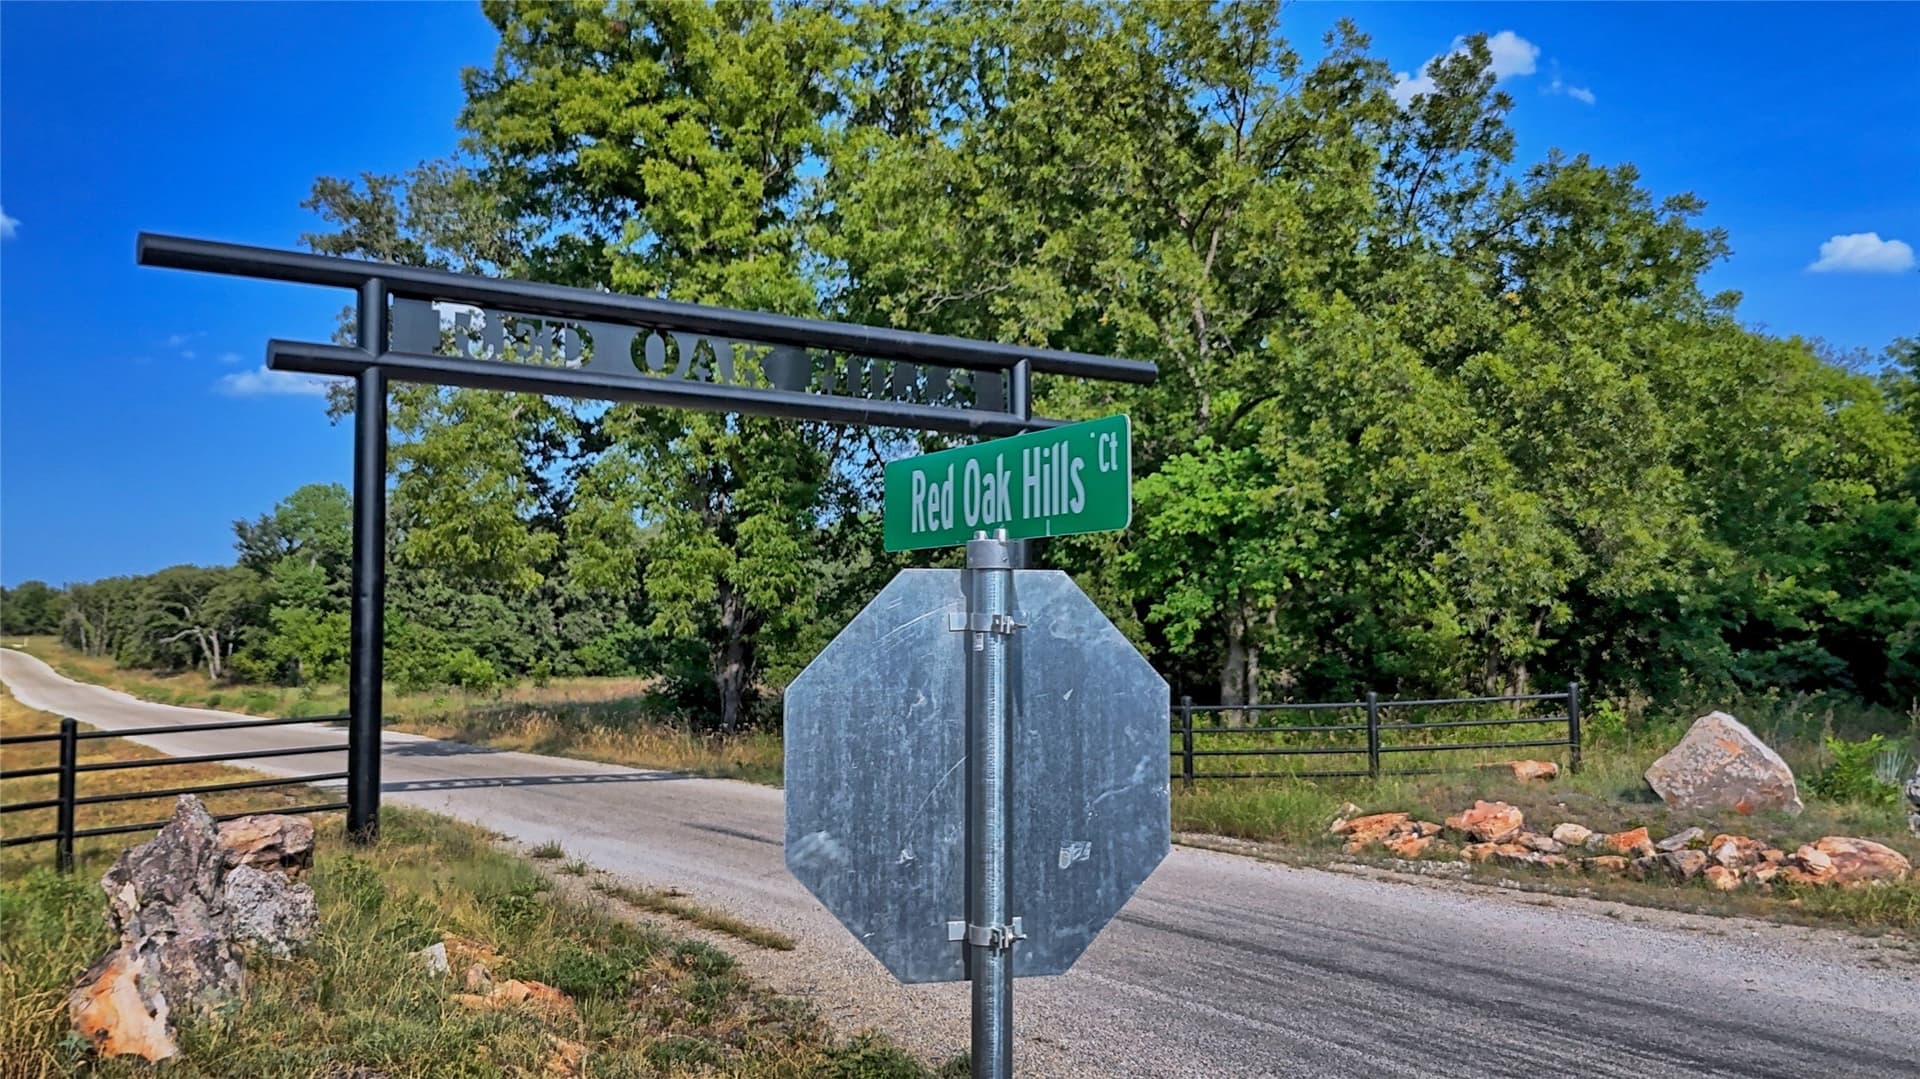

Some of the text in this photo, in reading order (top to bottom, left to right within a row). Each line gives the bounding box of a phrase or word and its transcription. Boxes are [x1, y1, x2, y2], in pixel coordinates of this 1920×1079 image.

[431, 301, 977, 409] RED OAK HILLS
[911, 431, 1118, 533] Red Oak Hills Ct
